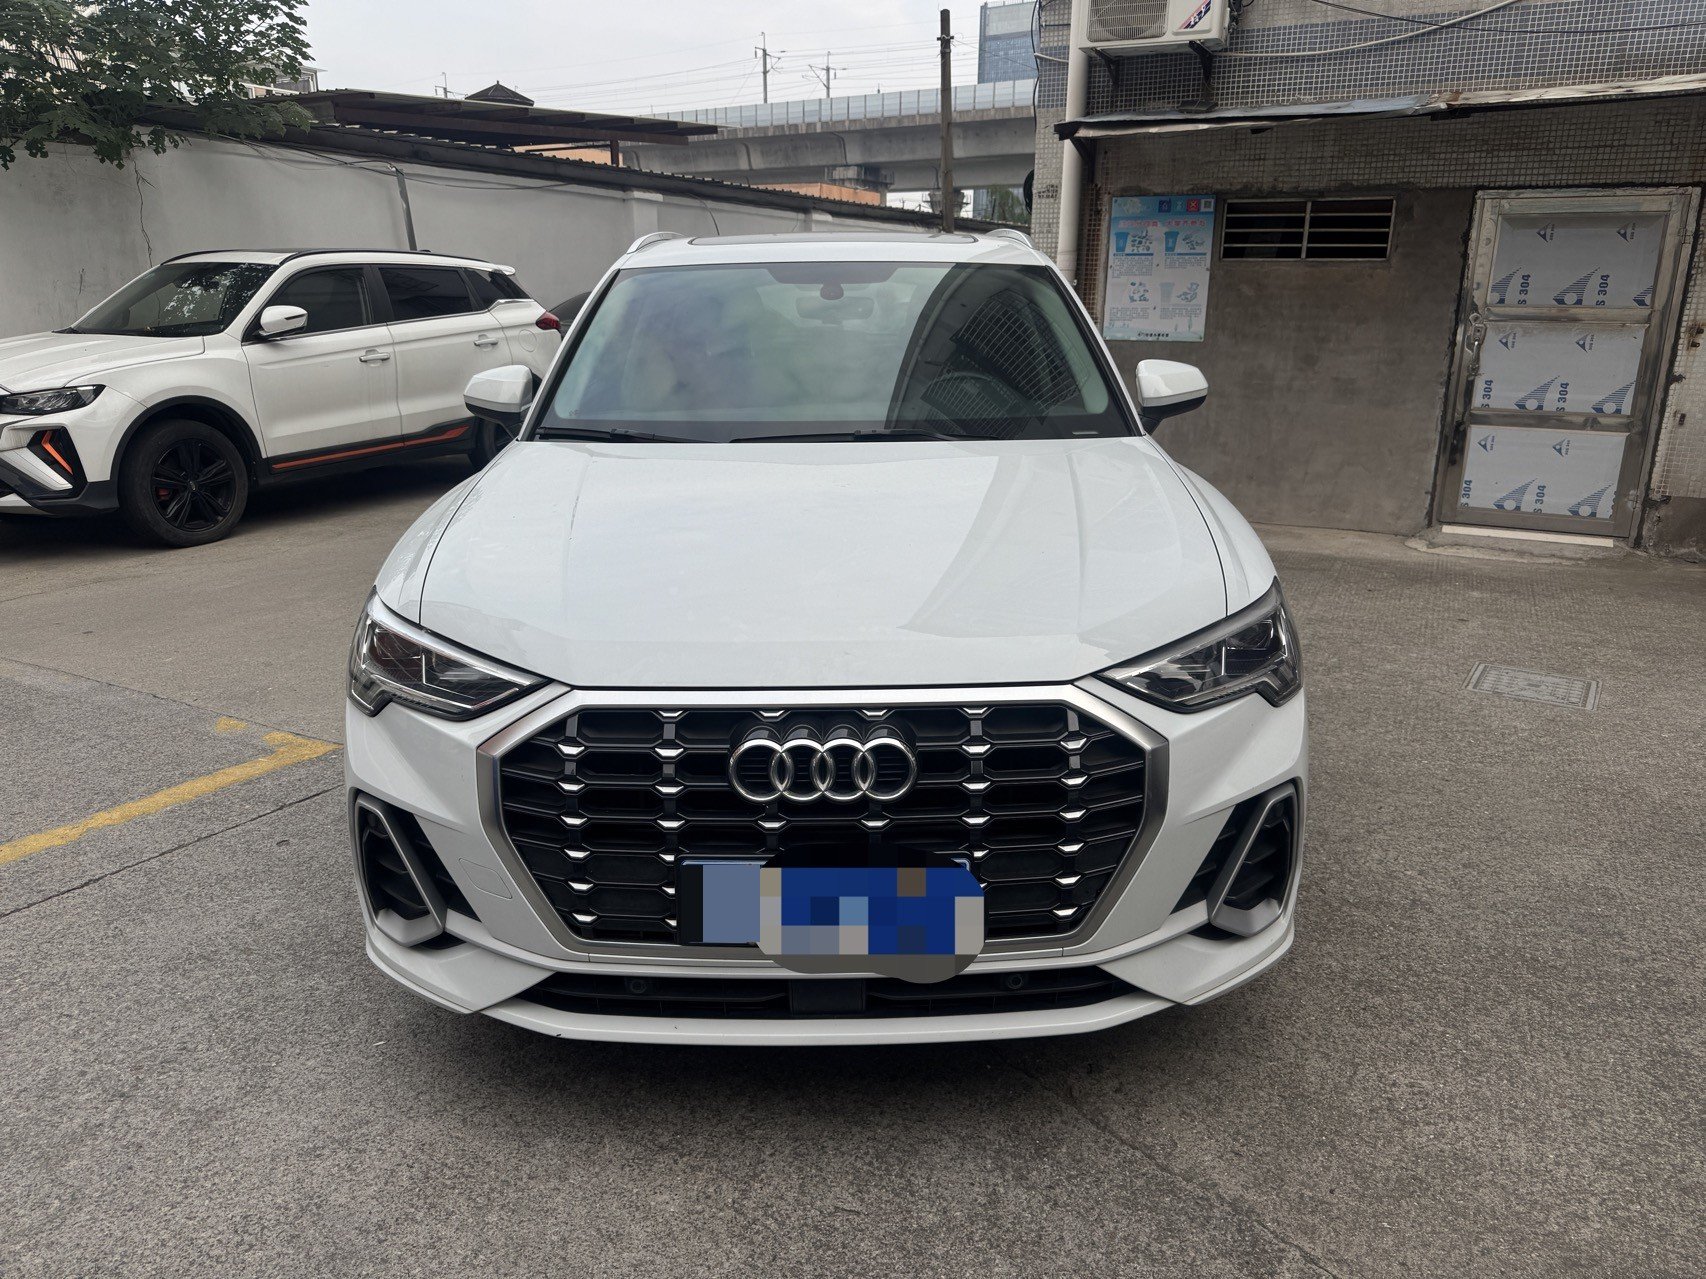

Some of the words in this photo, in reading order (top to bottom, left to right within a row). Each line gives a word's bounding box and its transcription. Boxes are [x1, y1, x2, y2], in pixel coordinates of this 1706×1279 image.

[1519, 274, 1531, 295] 304
[1597, 274, 1610, 296] 304
[1482, 379, 1494, 400] 304
[1557, 382, 1569, 403] 304
[1461, 479, 1473, 499] 304
[1534, 485, 1546, 504] 304
